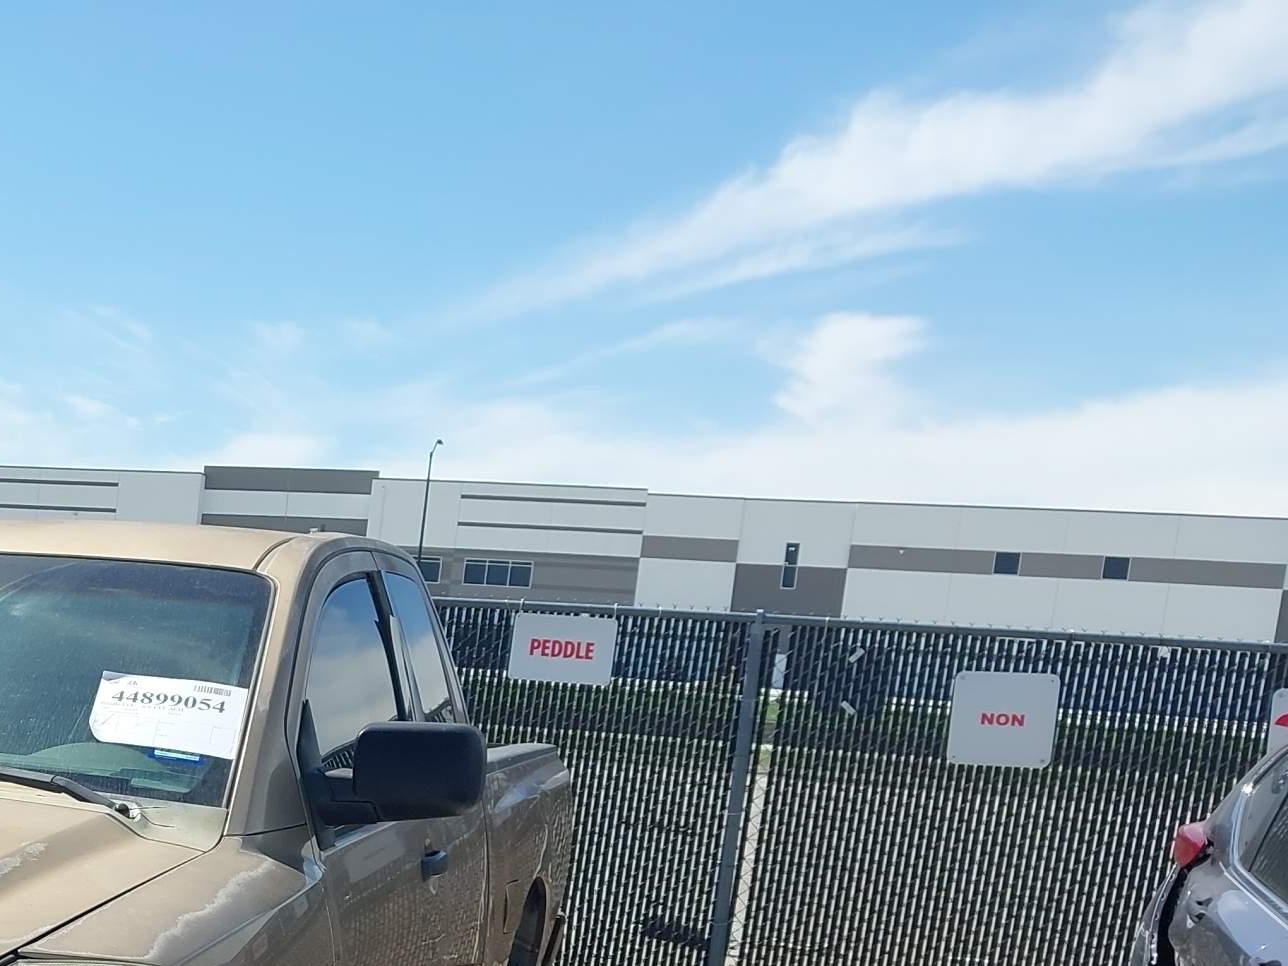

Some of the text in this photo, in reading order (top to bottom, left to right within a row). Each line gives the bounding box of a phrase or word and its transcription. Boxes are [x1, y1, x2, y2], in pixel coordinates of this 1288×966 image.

[529, 638, 595, 660] PEDDLE
[112, 690, 226, 713] 44899054
[980, 712, 1025, 727] NON
